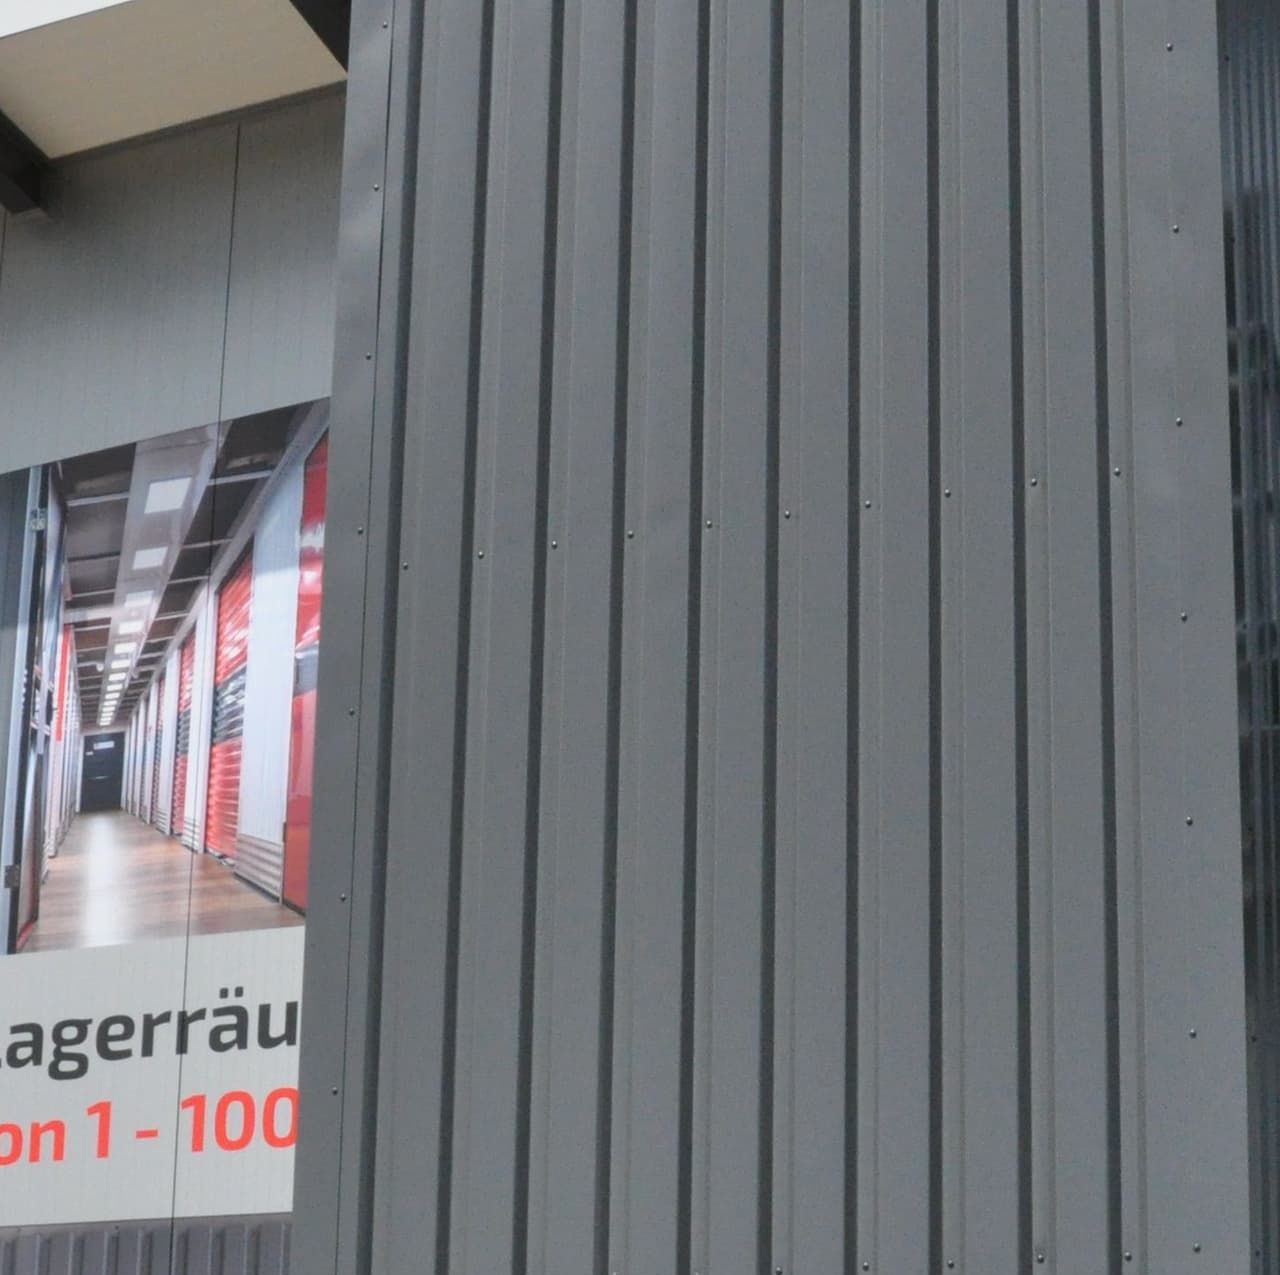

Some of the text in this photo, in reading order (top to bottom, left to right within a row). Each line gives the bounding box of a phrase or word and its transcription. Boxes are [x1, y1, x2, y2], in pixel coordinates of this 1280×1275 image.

[85, 1101, 113, 1159] 1
[135, 1128, 159, 1139] -
[179, 1087, 299, 1153] 100
